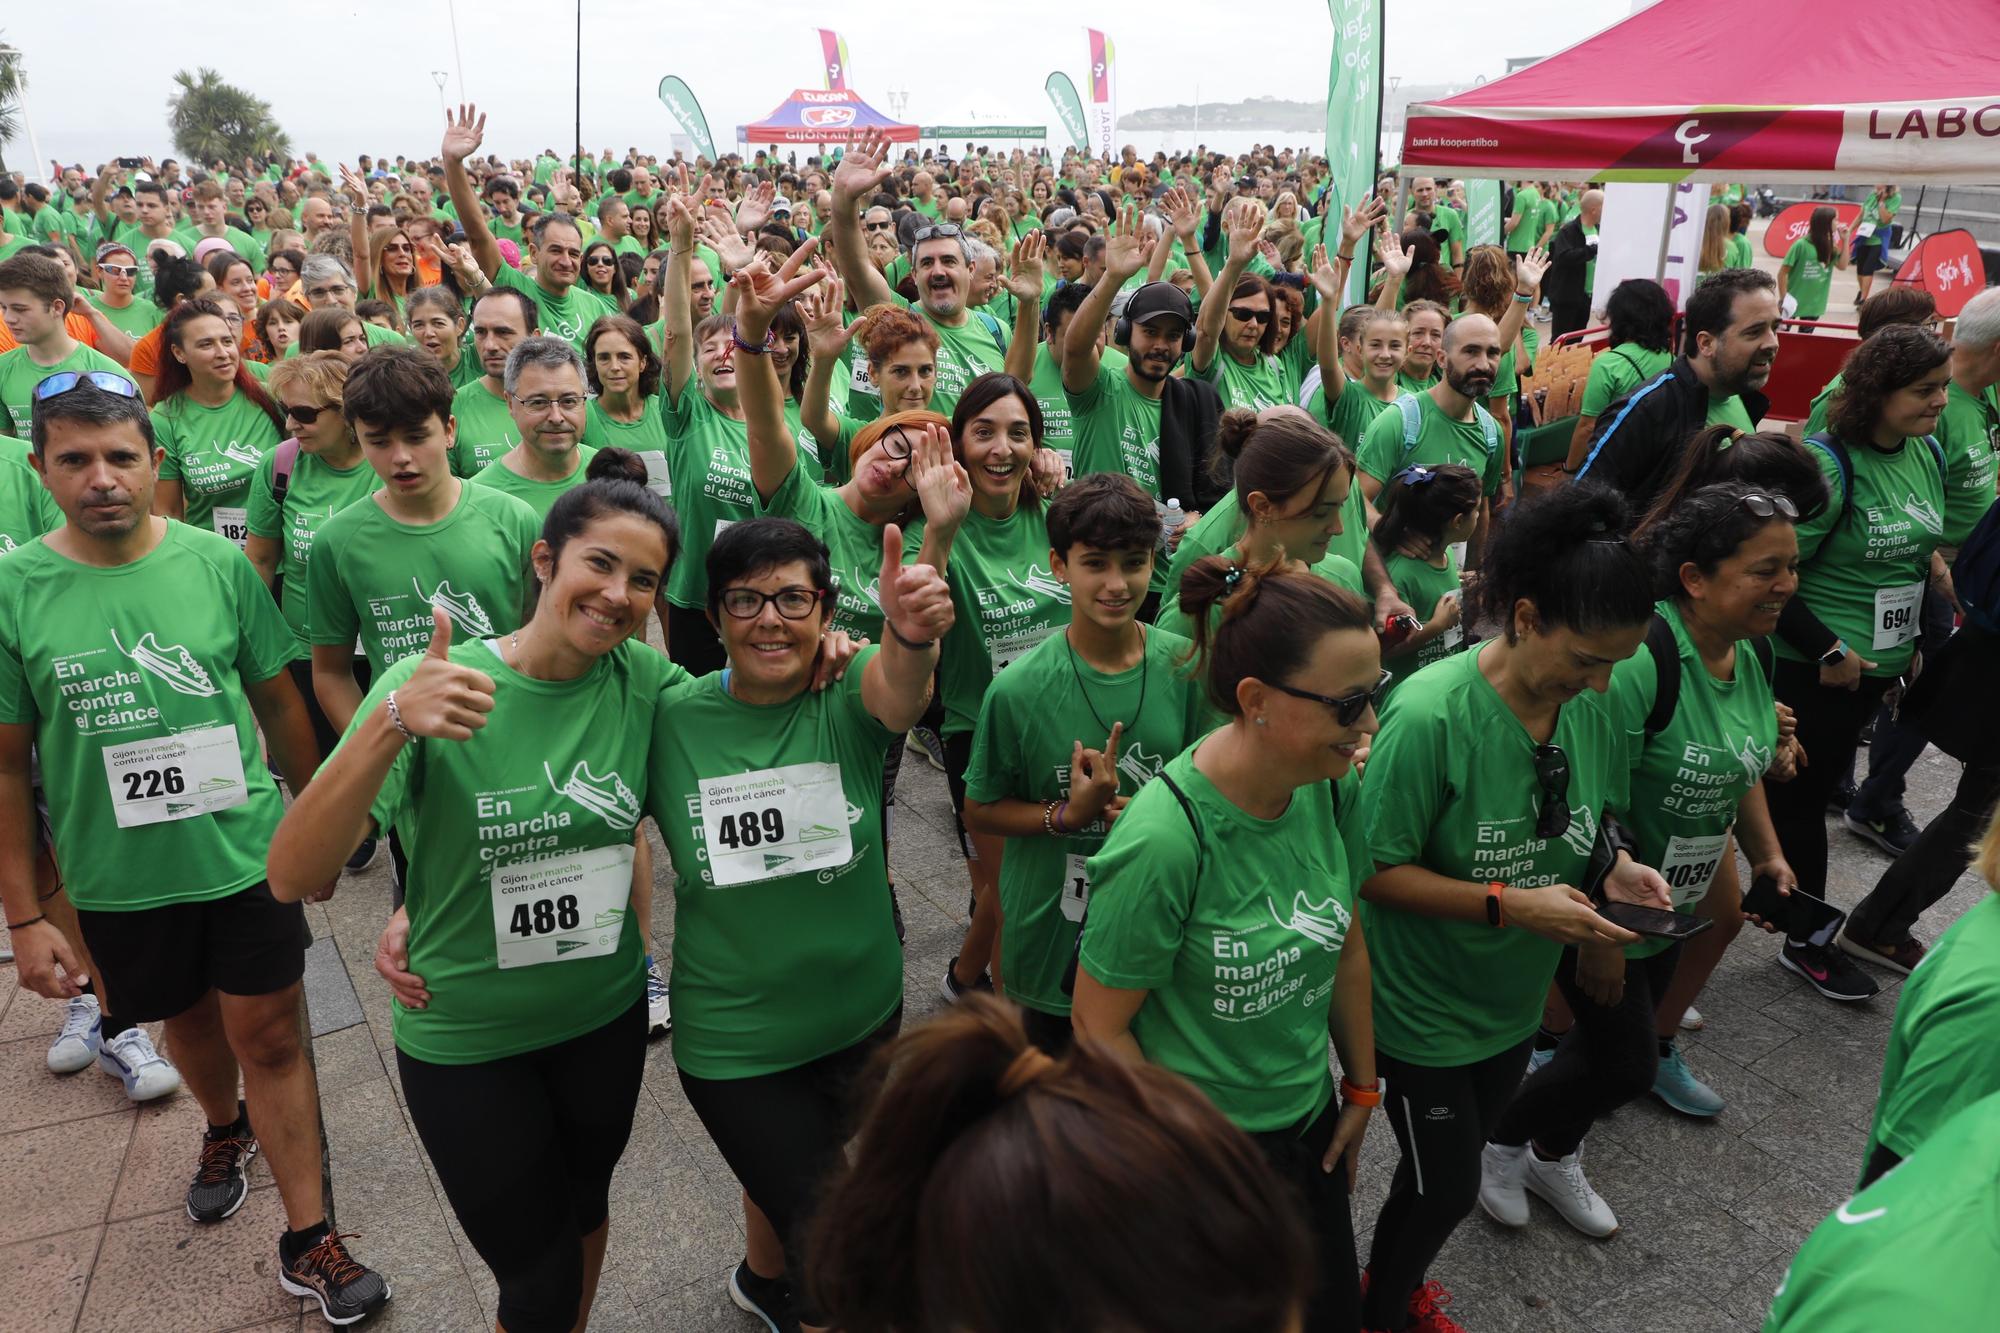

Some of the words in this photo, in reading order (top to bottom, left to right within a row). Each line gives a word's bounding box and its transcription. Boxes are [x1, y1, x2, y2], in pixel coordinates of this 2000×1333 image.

[1412, 137, 1439, 147] banka
[1440, 138, 1498, 148] kooperatiboa
[1122, 427, 1136, 441] En
[185, 456, 200, 466] En
[474, 447, 490, 457] En
[712, 449, 728, 462] En
[1968, 446, 1981, 458] En
[188, 462, 231, 476] marcha
[1123, 453, 1149, 470] ontra
[191, 473, 228, 485] contra
[706, 473, 746, 490] contra
[1127, 466, 1157, 484] cánce
[206, 477, 247, 493] cáncer
[704, 484, 715, 494] el
[718, 489, 754, 505] cánce
[295, 514, 308, 526] En
[1868, 511, 1884, 523] En
[1868, 519, 1912, 535] marcha
[1868, 534, 1908, 547] contra
[1865, 549, 1880, 560] el
[1883, 543, 1920, 559] cáncer
[977, 591, 998, 606] En
[370, 603, 391, 616] En
[981, 596, 1036, 620] marcha
[376, 614, 436, 631] marcha
[983, 616, 1031, 633] contra
[1882, 607, 1912, 630] 694
[381, 632, 429, 647] contra
[383, 651, 394, 664] el
[54, 660, 85, 679] En
[60, 669, 141, 696] marcha
[68, 691, 136, 712] contra
[75, 713, 88, 729] el
[112, 748, 136, 760] Gijón
[137, 746, 149, 755] en
[150, 741, 185, 753] marcha
[114, 757, 144, 767] contra
[146, 753, 154, 762] el
[156, 749, 187, 760] cáncer
[1682, 745, 1710, 767] En
[122, 766, 185, 800] 226
[1676, 766, 1740, 785] marcha
[708, 787, 733, 796] Gijón
[734, 784, 747, 792] en
[748, 777, 785, 789] marcha
[1670, 782, 1724, 799] contra
[709, 796, 741, 807] contra
[742, 792, 752, 801] el
[753, 787, 787, 799] cáncer
[1663, 796, 1683, 810] el
[477, 797, 512, 819] En
[478, 811, 572, 841] marcha
[719, 807, 785, 849] 489
[1477, 826, 1506, 843] En
[480, 835, 558, 861] contra
[1474, 839, 1547, 862] marcha
[500, 873, 528, 886] Gijón
[530, 872, 543, 881] en
[545, 863, 583, 878] marcha
[1471, 859, 1534, 879] contra
[1665, 859, 1717, 888] 1039
[501, 884, 536, 895] contra
[538, 880, 548, 889] el
[550, 872, 584, 886] cáncer
[510, 894, 580, 937] 488
[1213, 937, 1249, 959] En
[1215, 947, 1301, 980] marcha
[1214, 968, 1285, 997] contra
[1214, 998, 1235, 1015] el
[1243, 973, 1307, 1014] cáncer
